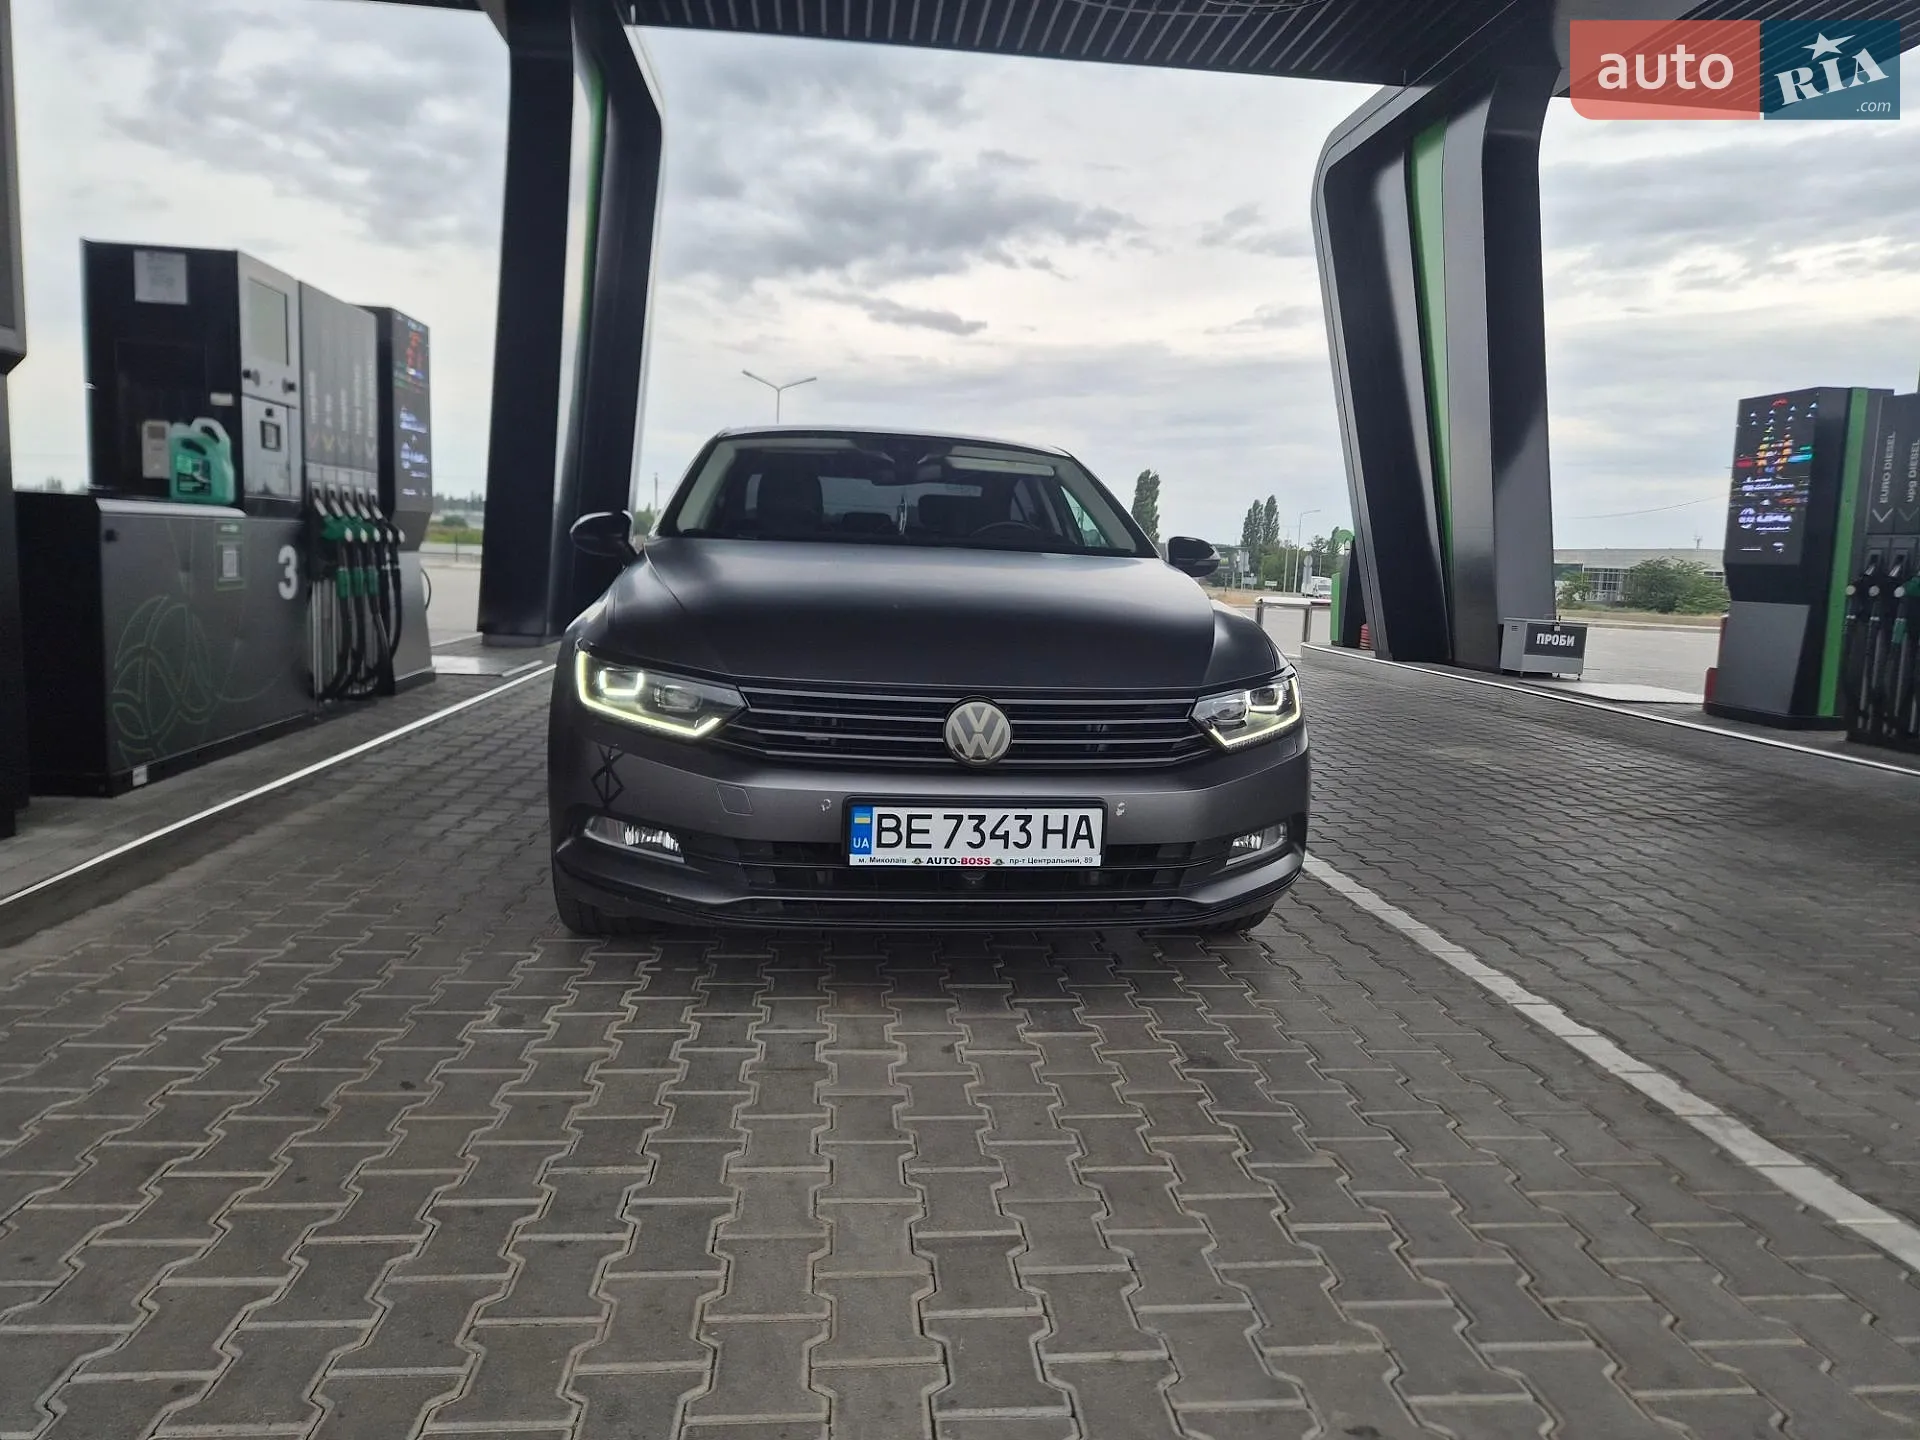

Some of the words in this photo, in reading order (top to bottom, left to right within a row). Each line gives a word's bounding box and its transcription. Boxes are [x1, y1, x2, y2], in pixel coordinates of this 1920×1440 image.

[1884, 431, 1897, 470] DIESEL
[1908, 439, 1920, 479] DIESEL
[1879, 472, 1892, 504] EURO
[278, 545, 297, 600] 3
[1535, 633, 1576, 647] ПРОБИ
[853, 837, 870, 849] UA
[876, 813, 933, 849] BE
[943, 814, 1033, 850] 7343
[1041, 814, 1096, 850] HA
[926, 857, 991, 865] AUTO-BOSS
[1084, 856, 1094, 864] 89
